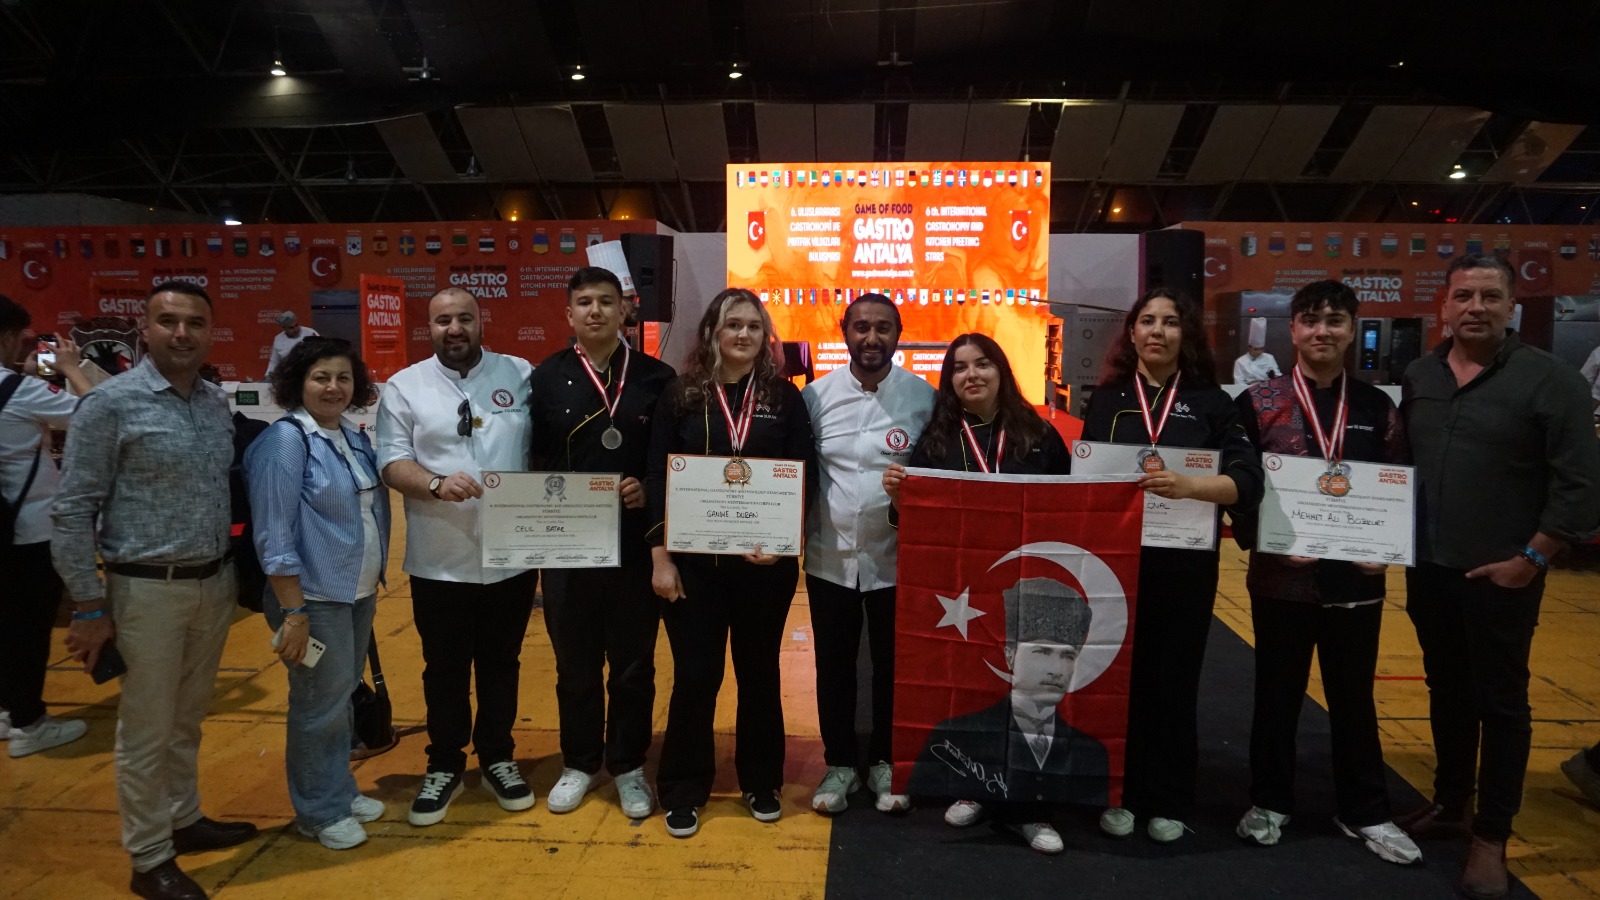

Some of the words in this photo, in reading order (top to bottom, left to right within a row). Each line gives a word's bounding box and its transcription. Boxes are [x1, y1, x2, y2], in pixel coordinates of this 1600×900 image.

[855, 204, 876, 214] GAME
[879, 204, 889, 214] OF
[892, 204, 913, 214] FOOD
[925, 206, 930, 216] 6
[940, 206, 987, 216] INTERNATIONAL
[854, 218, 914, 240] GASTRO
[925, 222, 970, 231] GASTRONOMY
[970, 222, 984, 231] AND
[925, 236, 952, 246] KITCHEN
[952, 236, 980, 246] MEETING
[854, 243, 913, 264] ANTALYA
[925, 252, 944, 261] STARS
[449, 273, 508, 286] GASTRO
[1341, 276, 1403, 290] GASTRO
[466, 286, 508, 298] TALYA
[1355, 290, 1401, 302] NTALYA
[367, 294, 400, 311] GASTRO
[368, 311, 401, 326] ANTALYA
